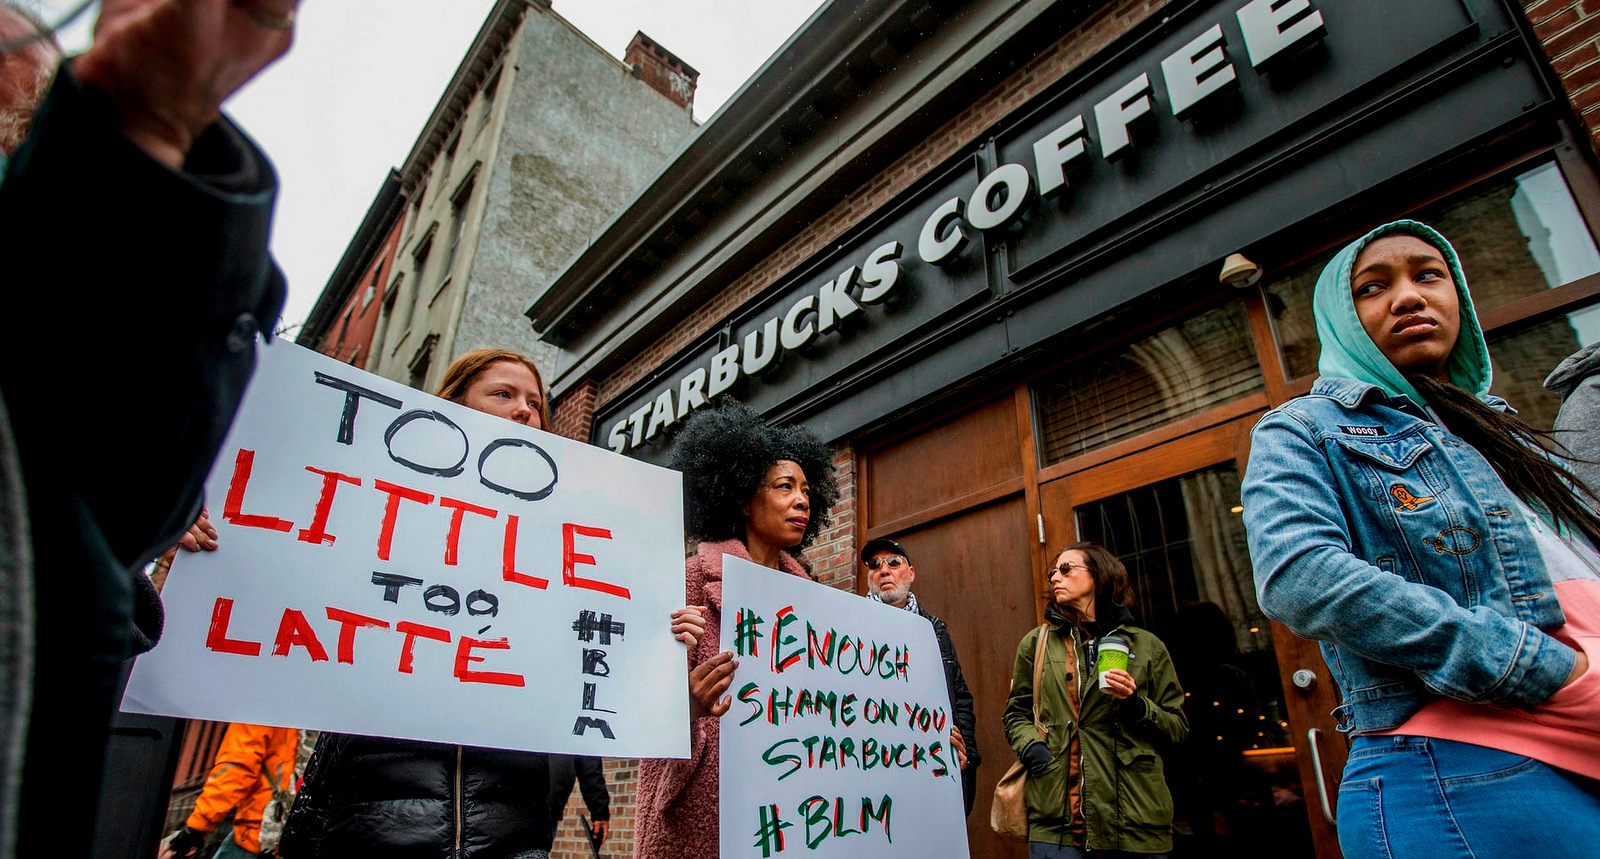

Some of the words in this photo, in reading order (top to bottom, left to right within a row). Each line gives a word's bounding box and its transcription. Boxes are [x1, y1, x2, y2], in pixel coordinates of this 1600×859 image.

[608, 240, 903, 454] STARBUCKS
[918, 0, 1324, 265] COFFEE
[314, 370, 558, 501] TOO
[222, 448, 631, 600] LITTLE
[371, 570, 499, 617] TOO
[205, 597, 525, 687] LATTÉ
[734, 605, 912, 683] #ENOUGH
[737, 682, 857, 727] SHAME
[863, 697, 899, 728] ON
[904, 701, 946, 734] YOU
[753, 793, 894, 859] #BLM
